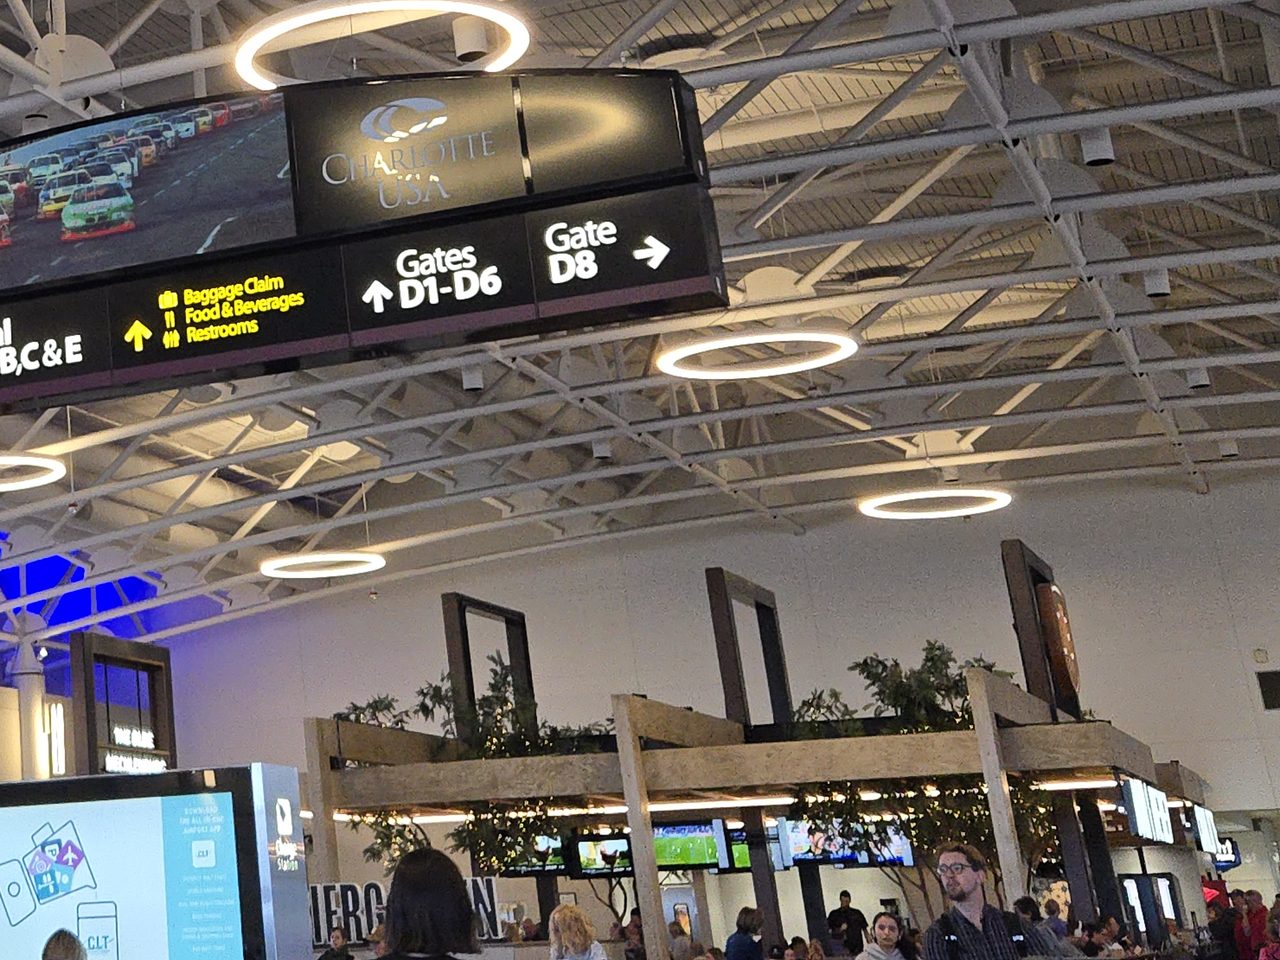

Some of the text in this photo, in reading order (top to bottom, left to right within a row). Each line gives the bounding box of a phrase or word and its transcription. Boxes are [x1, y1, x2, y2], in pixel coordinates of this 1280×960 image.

[322, 131, 496, 185] CHARLOTTE
[378, 173, 451, 209] USA
[545, 220, 617, 253] Gate
[396, 245, 477, 279] Gates
[548, 249, 599, 284] D8
[183, 275, 284, 306] Baggage Claim
[398, 265, 503, 310] D1-D6
[185, 292, 305, 324] Food & Beverages
[186, 319, 260, 343] Restrooms
[41, 338, 63, 367] &
[64, 334, 83, 364] E
